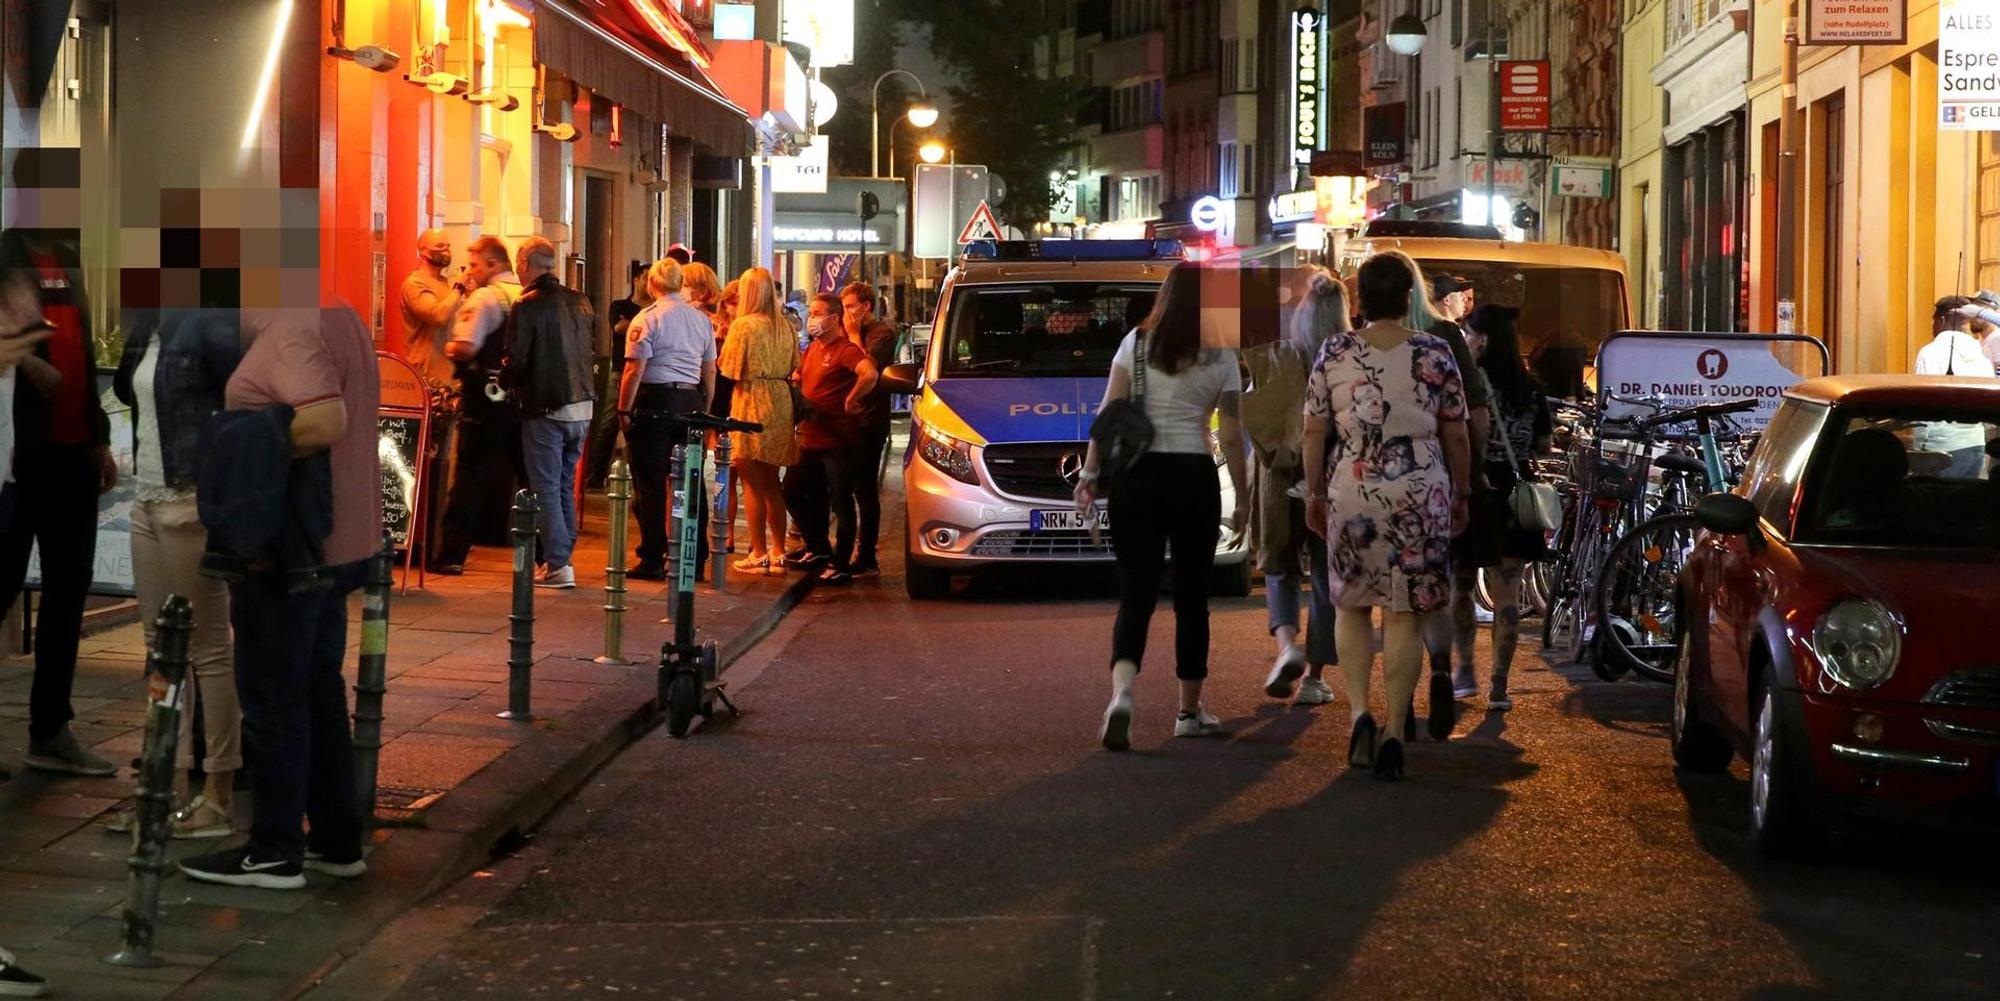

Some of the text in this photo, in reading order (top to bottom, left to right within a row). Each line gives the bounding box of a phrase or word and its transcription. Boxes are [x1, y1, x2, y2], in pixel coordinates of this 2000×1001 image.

[1849, 5, 1889, 14] Relaxen
[1945, 15, 1992, 29] ALLES
[1943, 72, 2000, 92] Sand
[1969, 106, 2000, 118] GEL
[1370, 142, 1398, 150] KLEIN
[1472, 161, 1525, 184] Kosk
[1620, 382, 1792, 398] DR. DANIEL TODOROV
[1040, 512, 1067, 528] NRW
[682, 525, 697, 586] TIER
